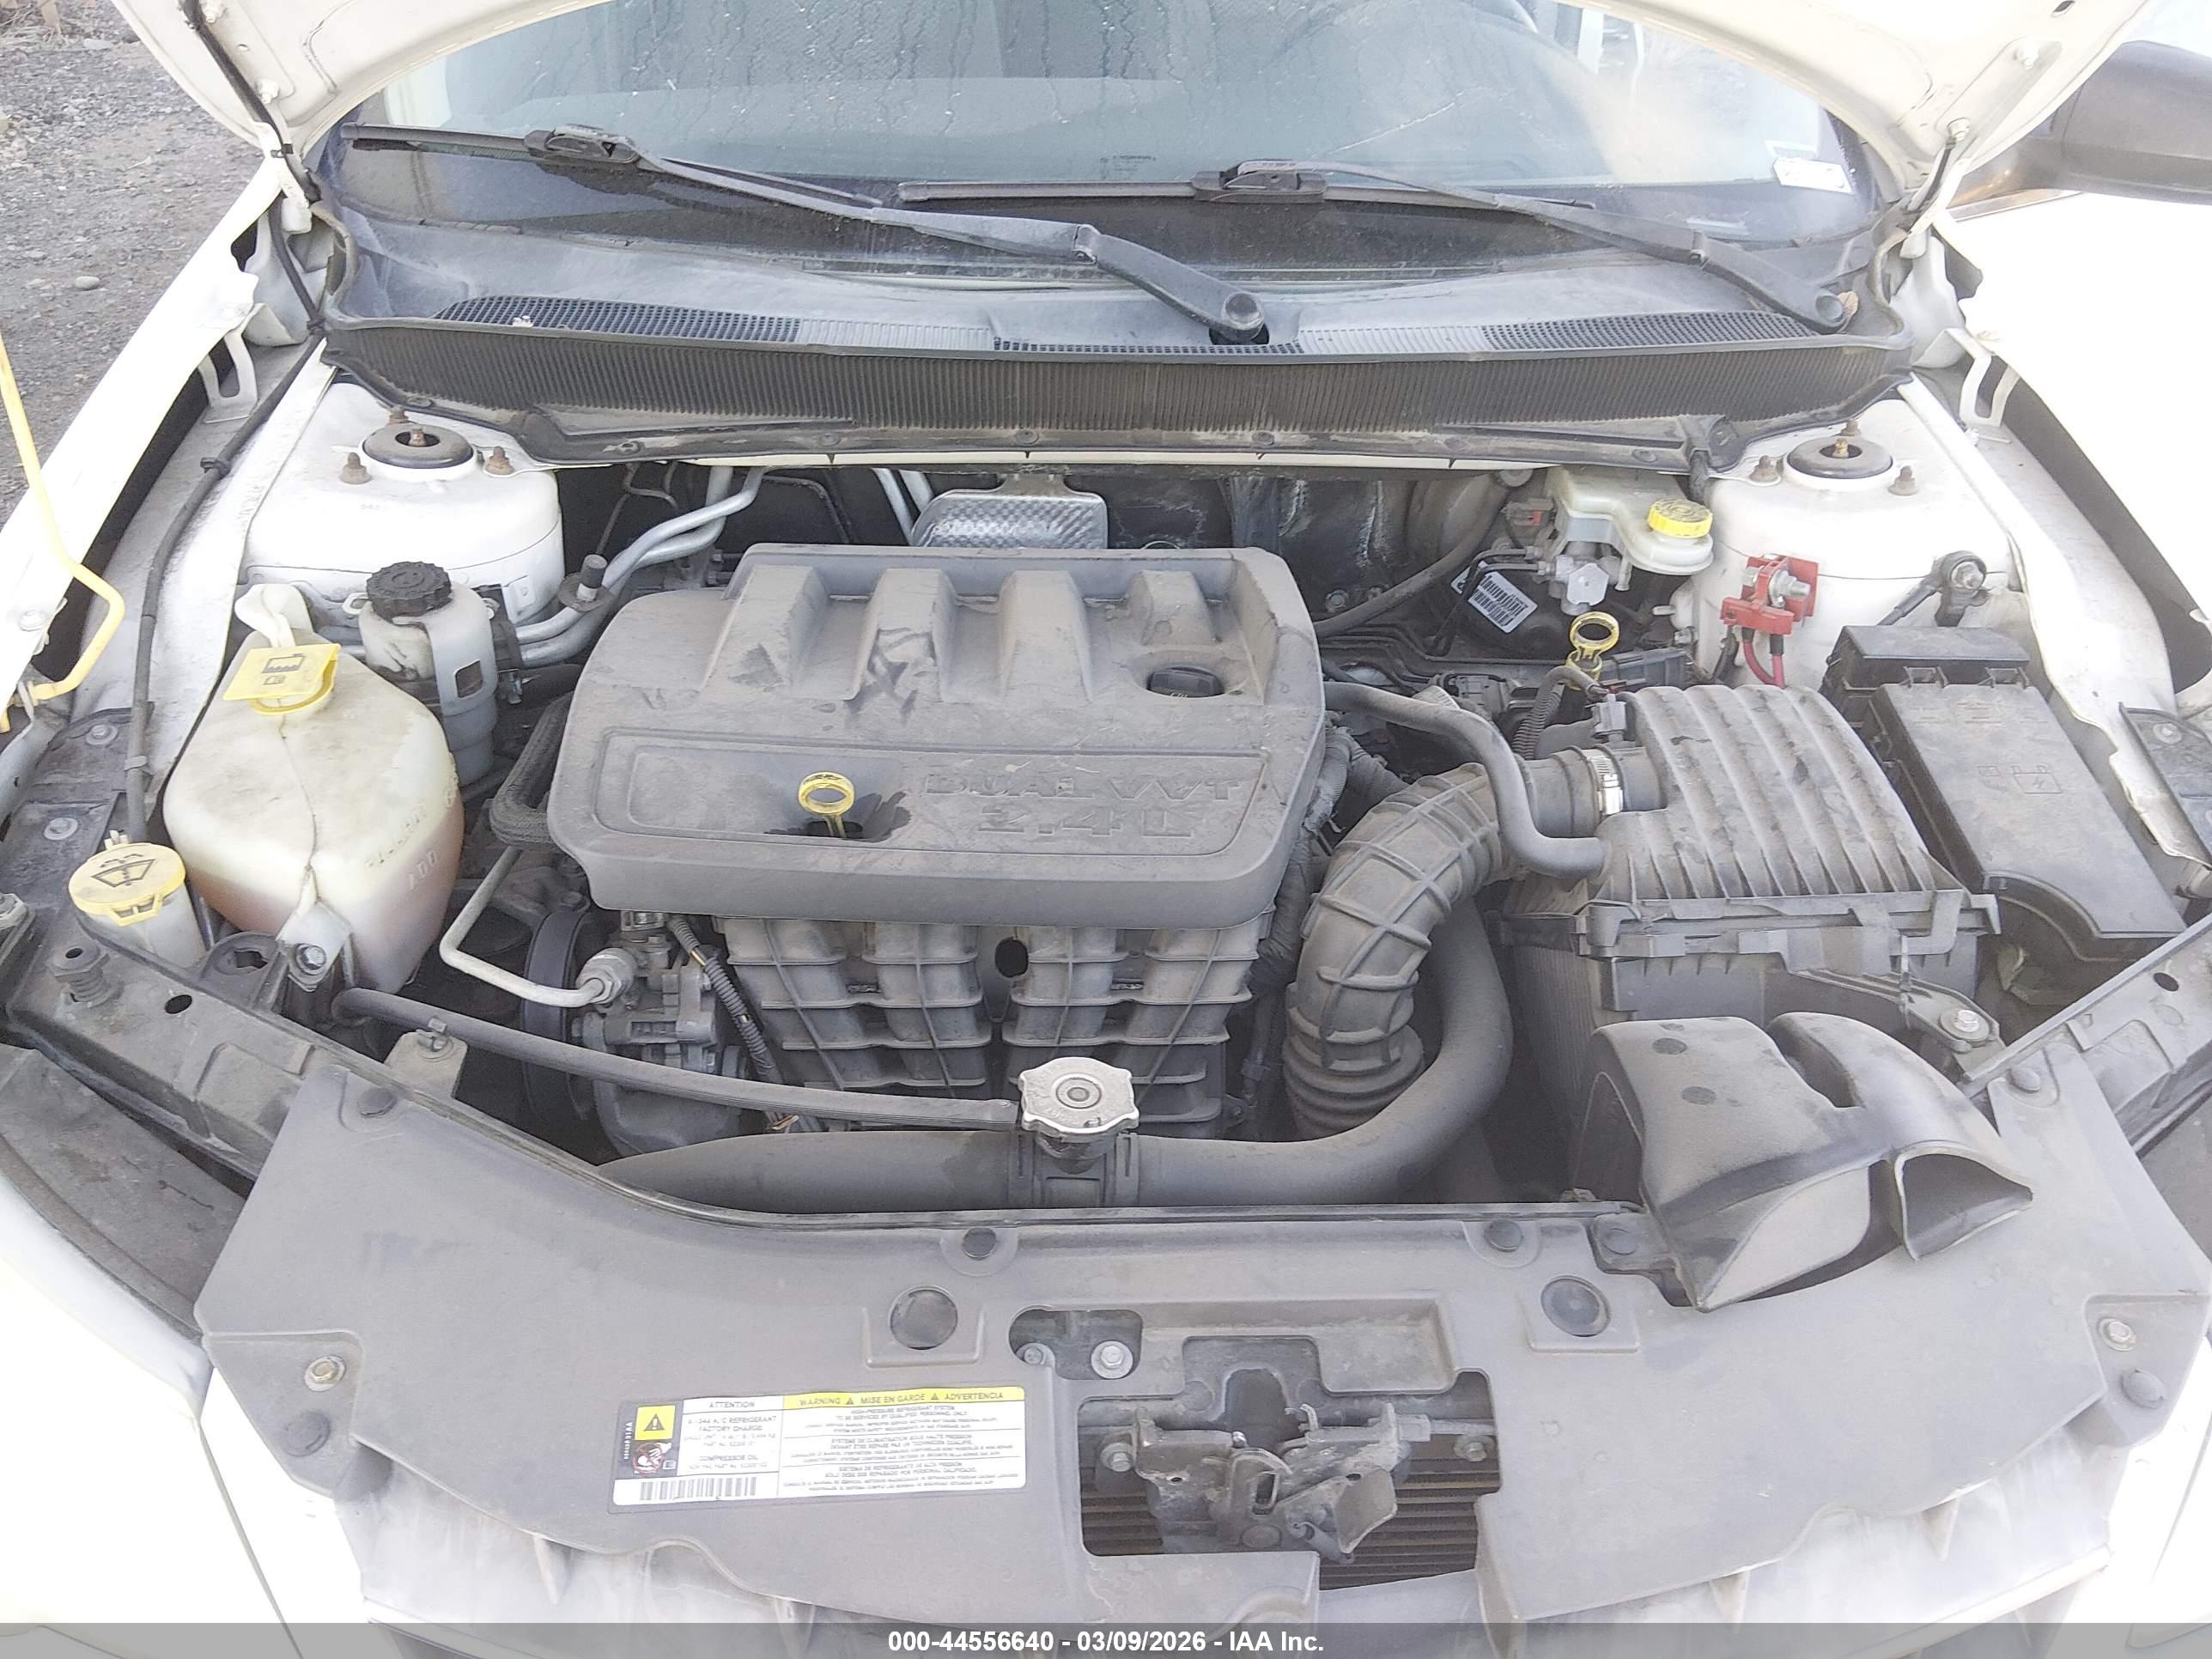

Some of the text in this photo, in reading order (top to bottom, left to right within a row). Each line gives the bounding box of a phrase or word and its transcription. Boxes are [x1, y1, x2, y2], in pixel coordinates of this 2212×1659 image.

[896, 1393, 927, 1402] GARDE
[945, 1392, 1004, 1401] ADVERTENCIA
[799, 1397, 841, 1406] WARNING
